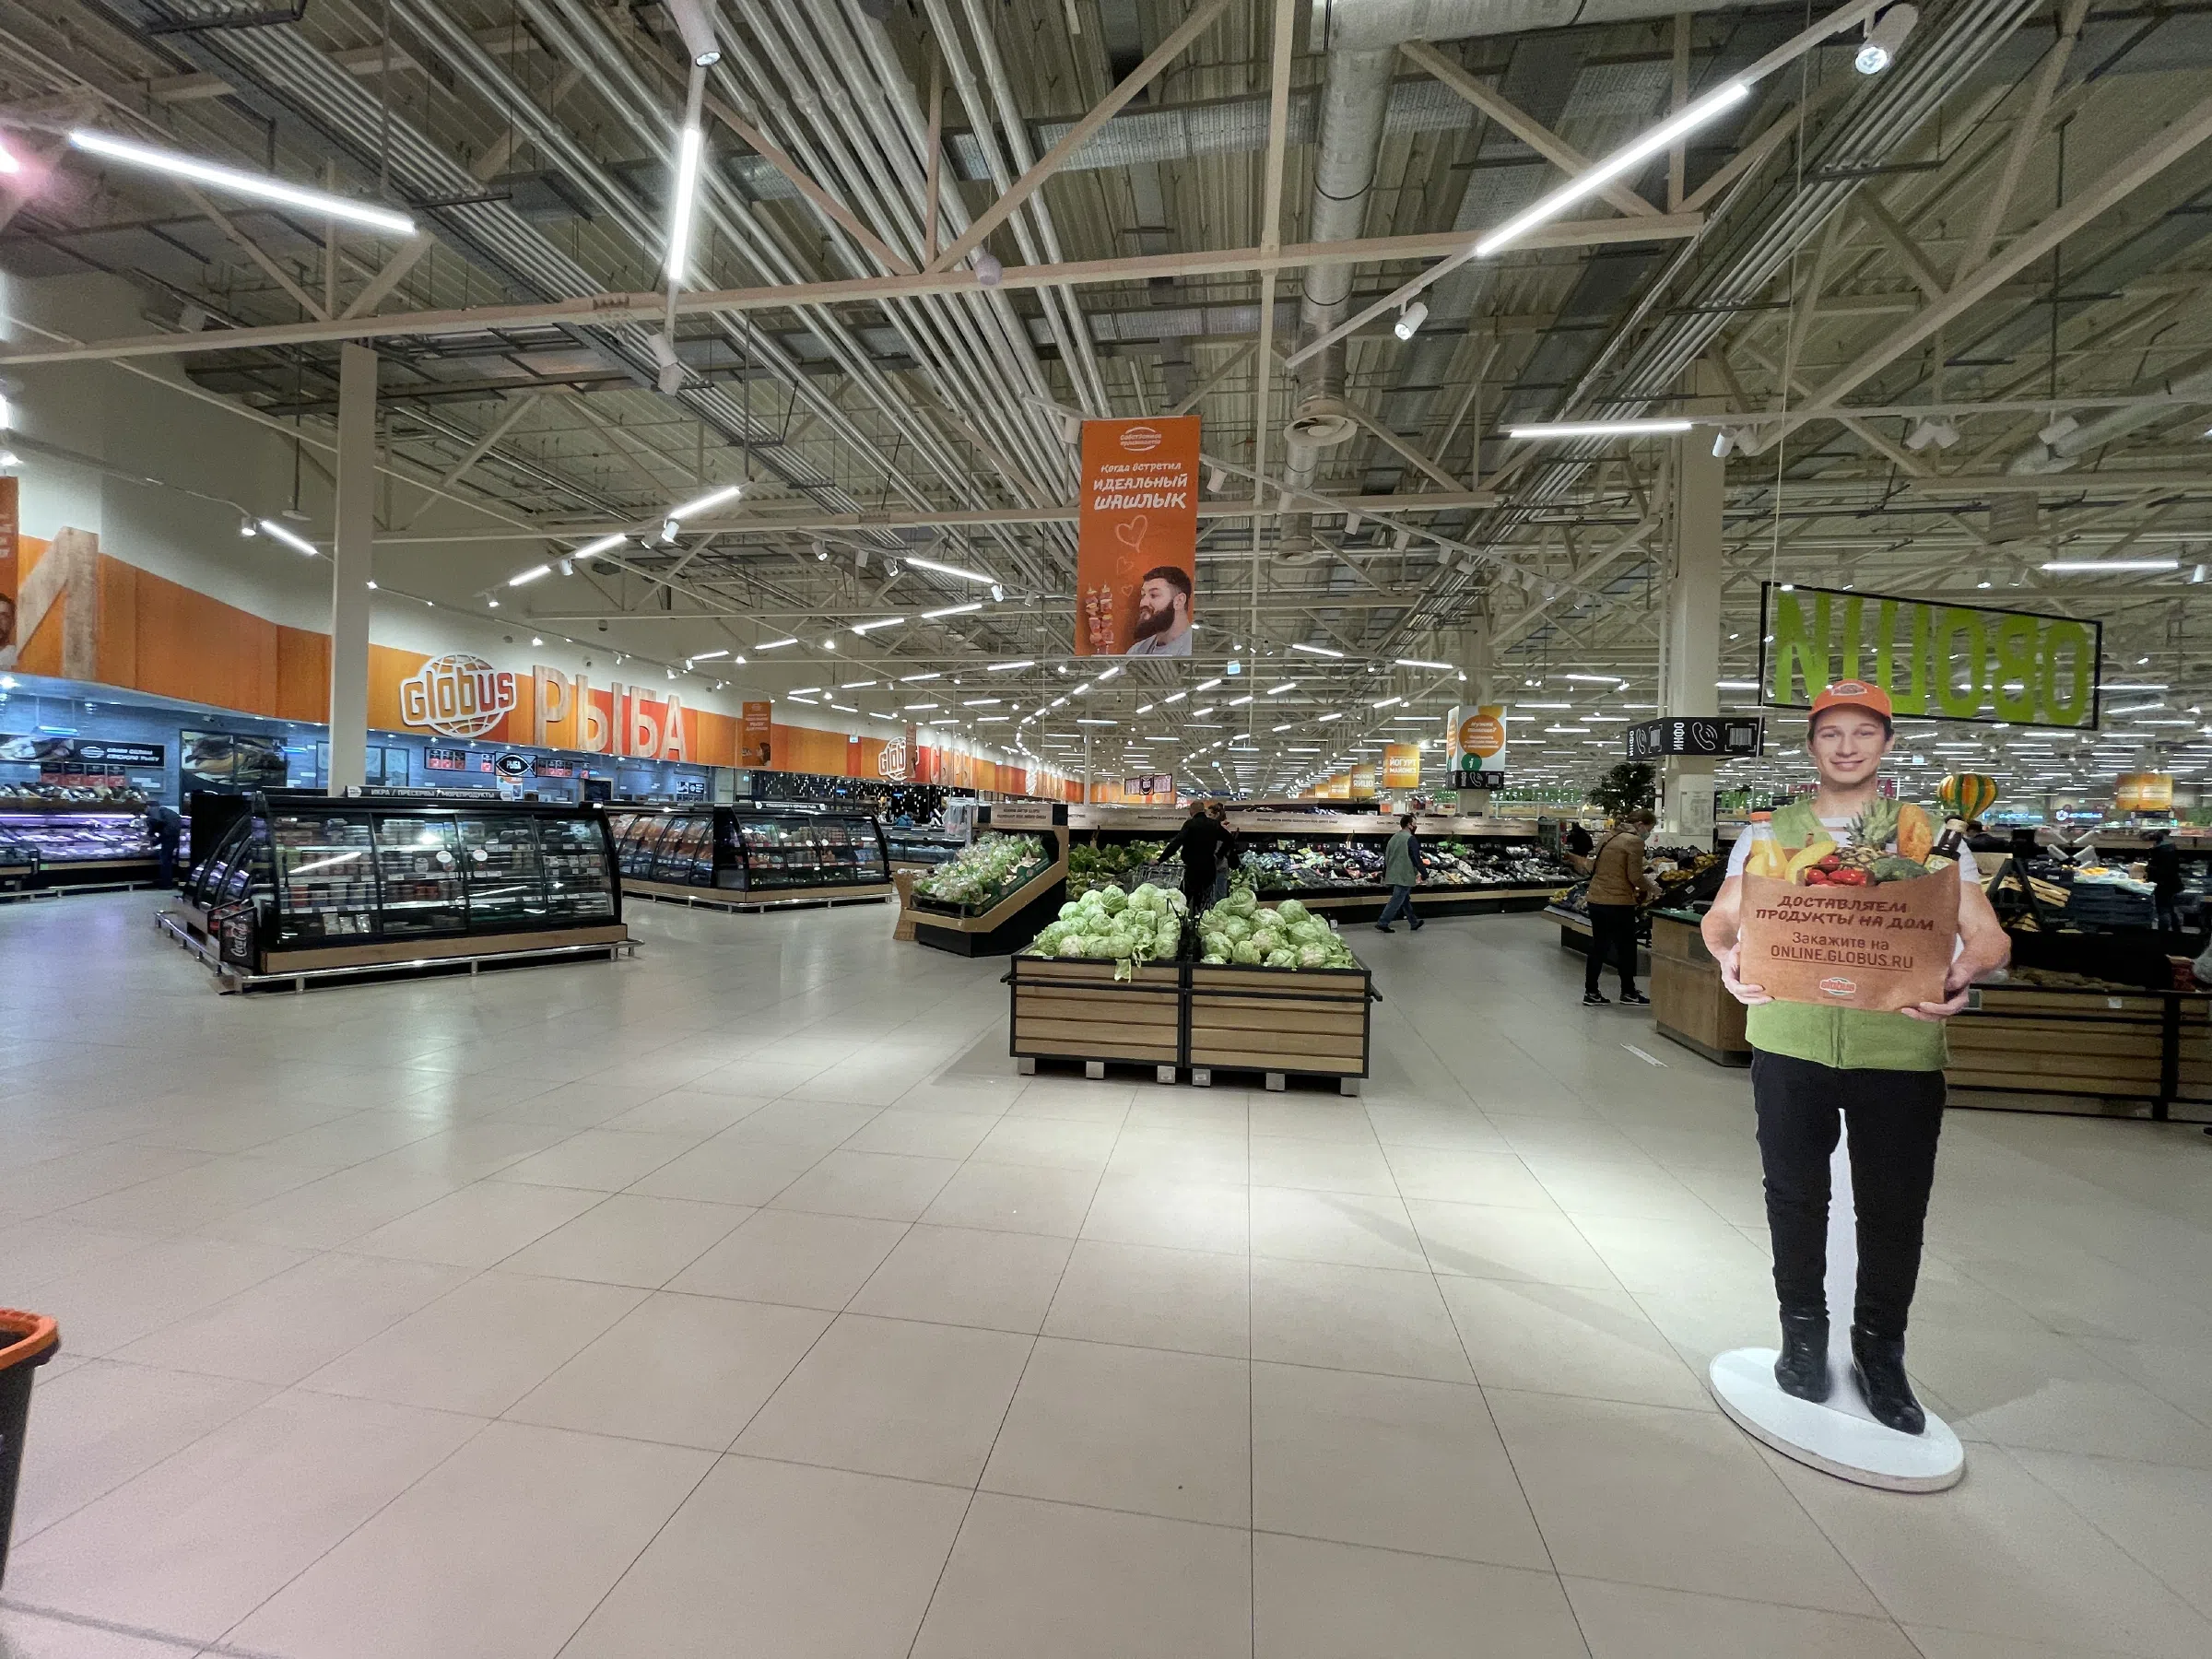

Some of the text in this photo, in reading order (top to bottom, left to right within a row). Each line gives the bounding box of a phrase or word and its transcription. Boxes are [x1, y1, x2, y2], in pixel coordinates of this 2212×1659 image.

[1100, 464, 1130, 473] Когда
[1093, 473, 1188, 492] ИДЕАЛЬНЫЙ
[1094, 492, 1187, 511] ШАШЛЫК
[532, 665, 687, 762] РЫБА
[1674, 722, 1685, 750] ИНФО
[506, 760, 522, 771] РЫБА
[930, 742, 977, 789] СЫРЫ
[1390, 758, 1417, 766] ЙОГУРТ
[371, 788, 391, 796] ИКРА
[1777, 895, 1907, 913] ДОСТАВЛЯЕМ
[1756, 909, 1935, 931] ПРОДУКТЫ НА ДОМ
[1792, 932, 1889, 951] Закажите на
[1771, 945, 1913, 969] ONLINE.GLOBUS.RU
